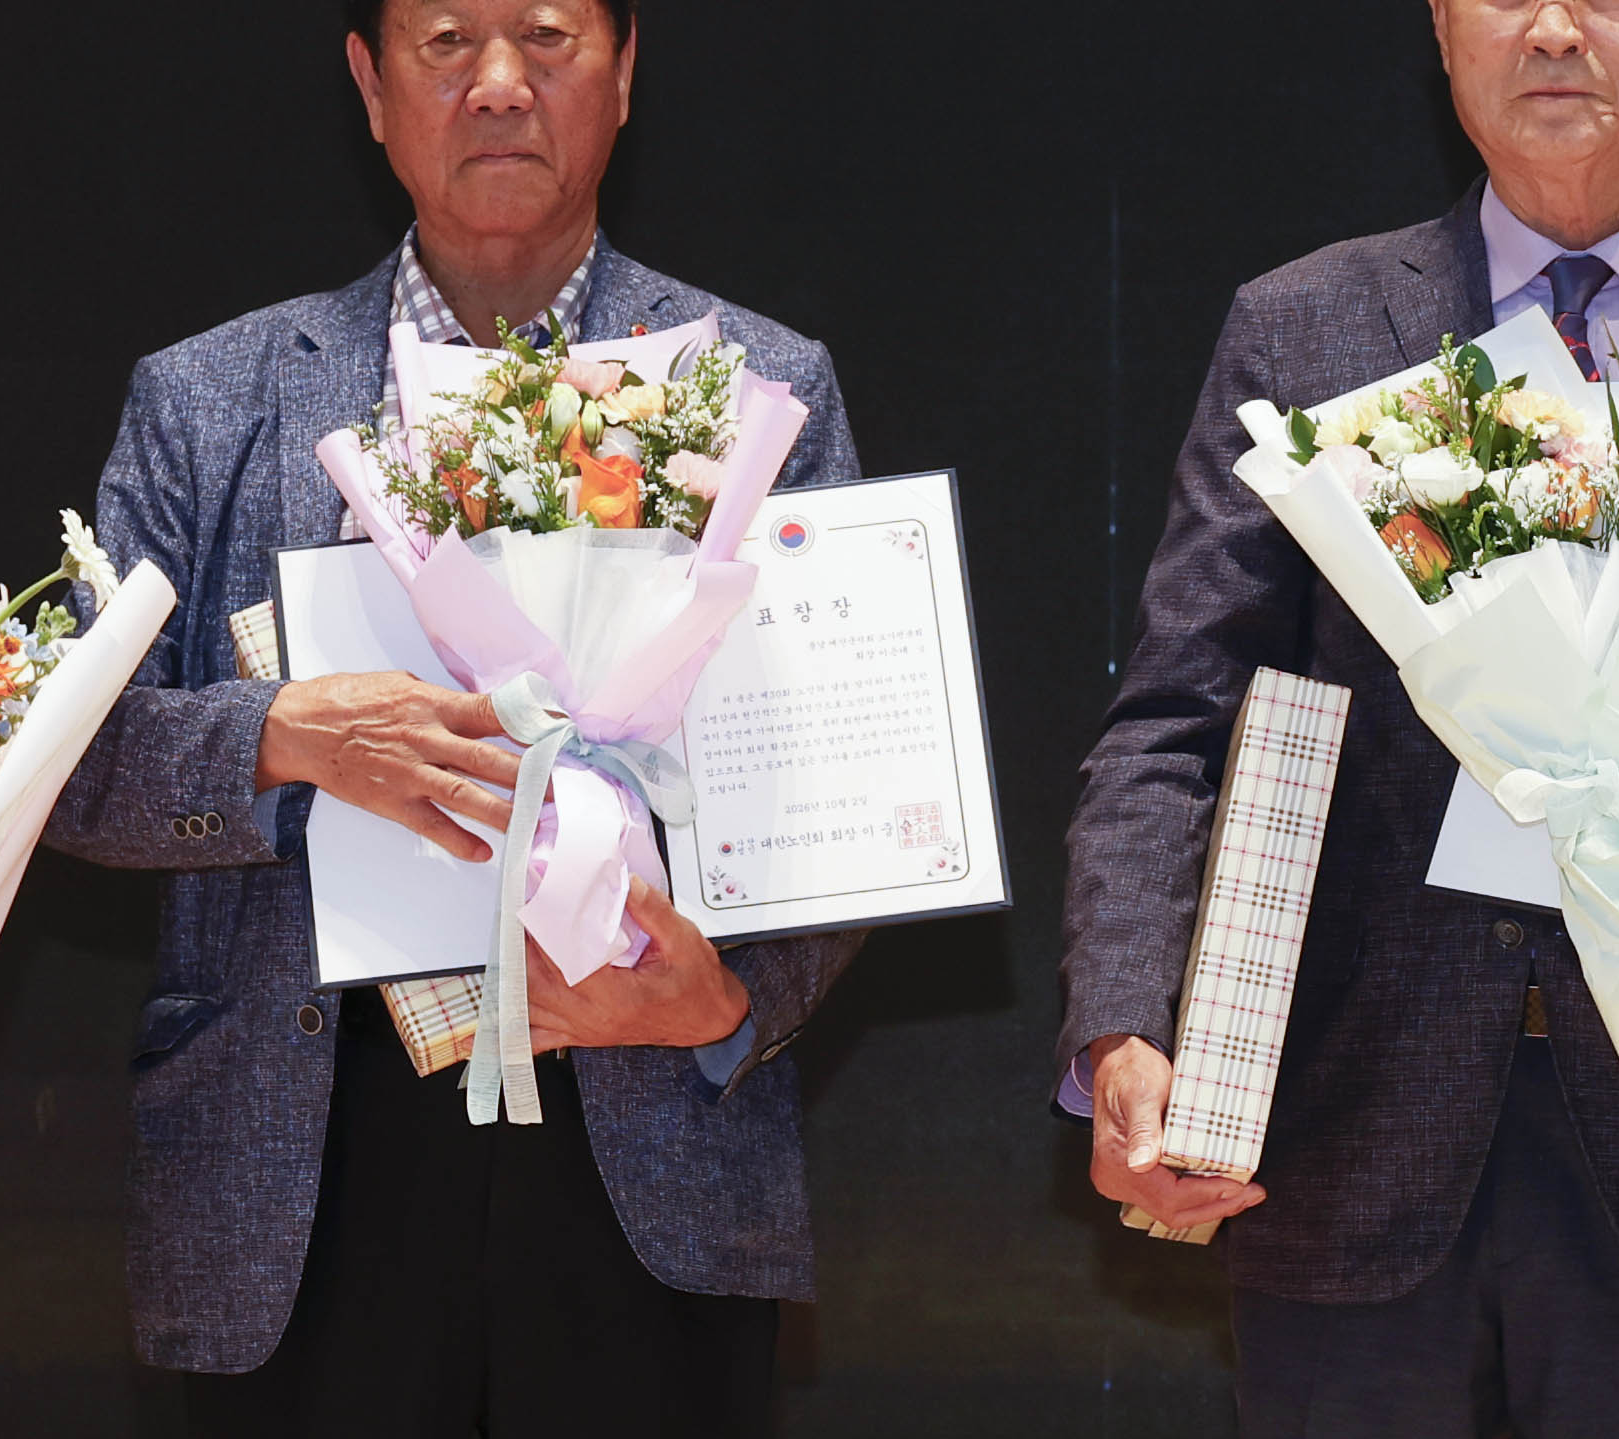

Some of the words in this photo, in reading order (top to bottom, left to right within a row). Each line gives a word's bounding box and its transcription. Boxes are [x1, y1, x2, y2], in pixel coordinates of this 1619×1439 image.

[784, 800, 821, 815] 2026년
[824, 797, 847, 810] 10월
[851, 794, 868, 807] 2일
[760, 828, 825, 853] 대한노인회
[829, 824, 858, 845] 회장
